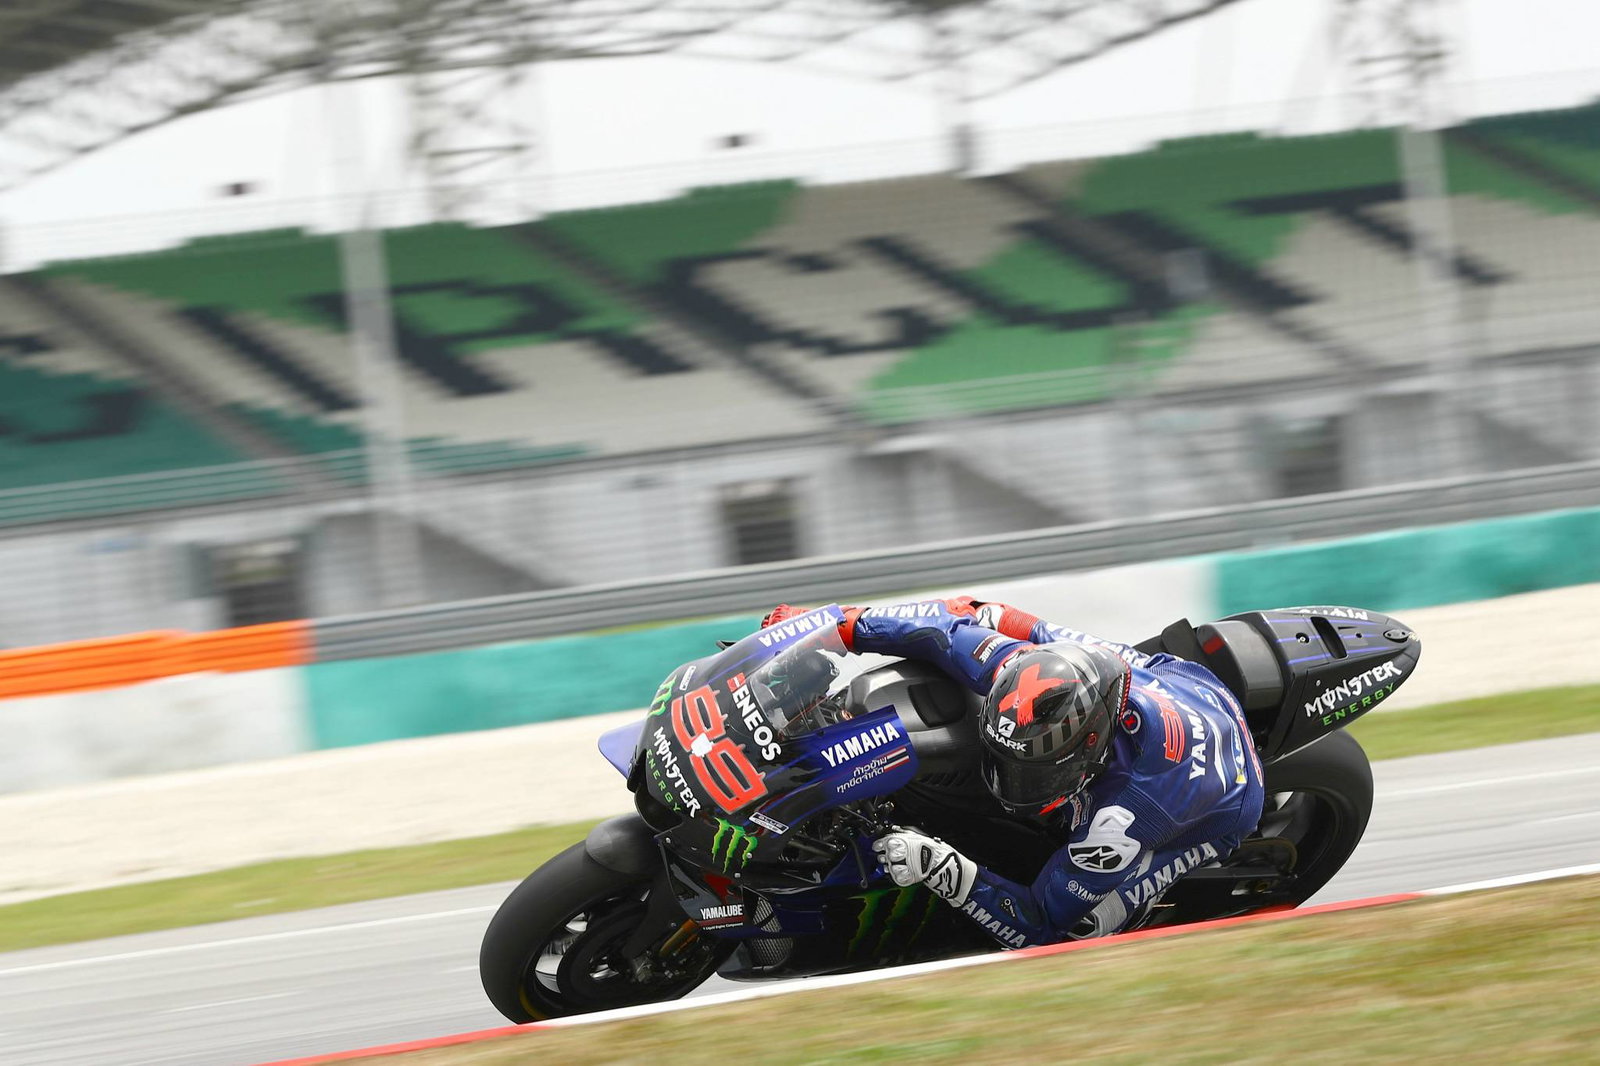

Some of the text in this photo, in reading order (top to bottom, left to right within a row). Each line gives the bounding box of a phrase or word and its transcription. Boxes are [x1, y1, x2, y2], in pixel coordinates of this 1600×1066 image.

[758, 610, 838, 648] YAMAHA
[1304, 660, 1402, 717] MONSTER
[1322, 682, 1395, 727] ENERGY
[730, 684, 782, 761] ENEOS
[820, 722, 901, 767] YAMAHA
[986, 721, 1027, 753] SHARK
[653, 726, 702, 818] MONSTER
[671, 685, 768, 814] 99
[646, 749, 682, 812] ENERGY
[1125, 842, 1219, 909] YAMAHA
[700, 904, 743, 920] YAMALUBE
[962, 899, 1027, 948] AMAHA
